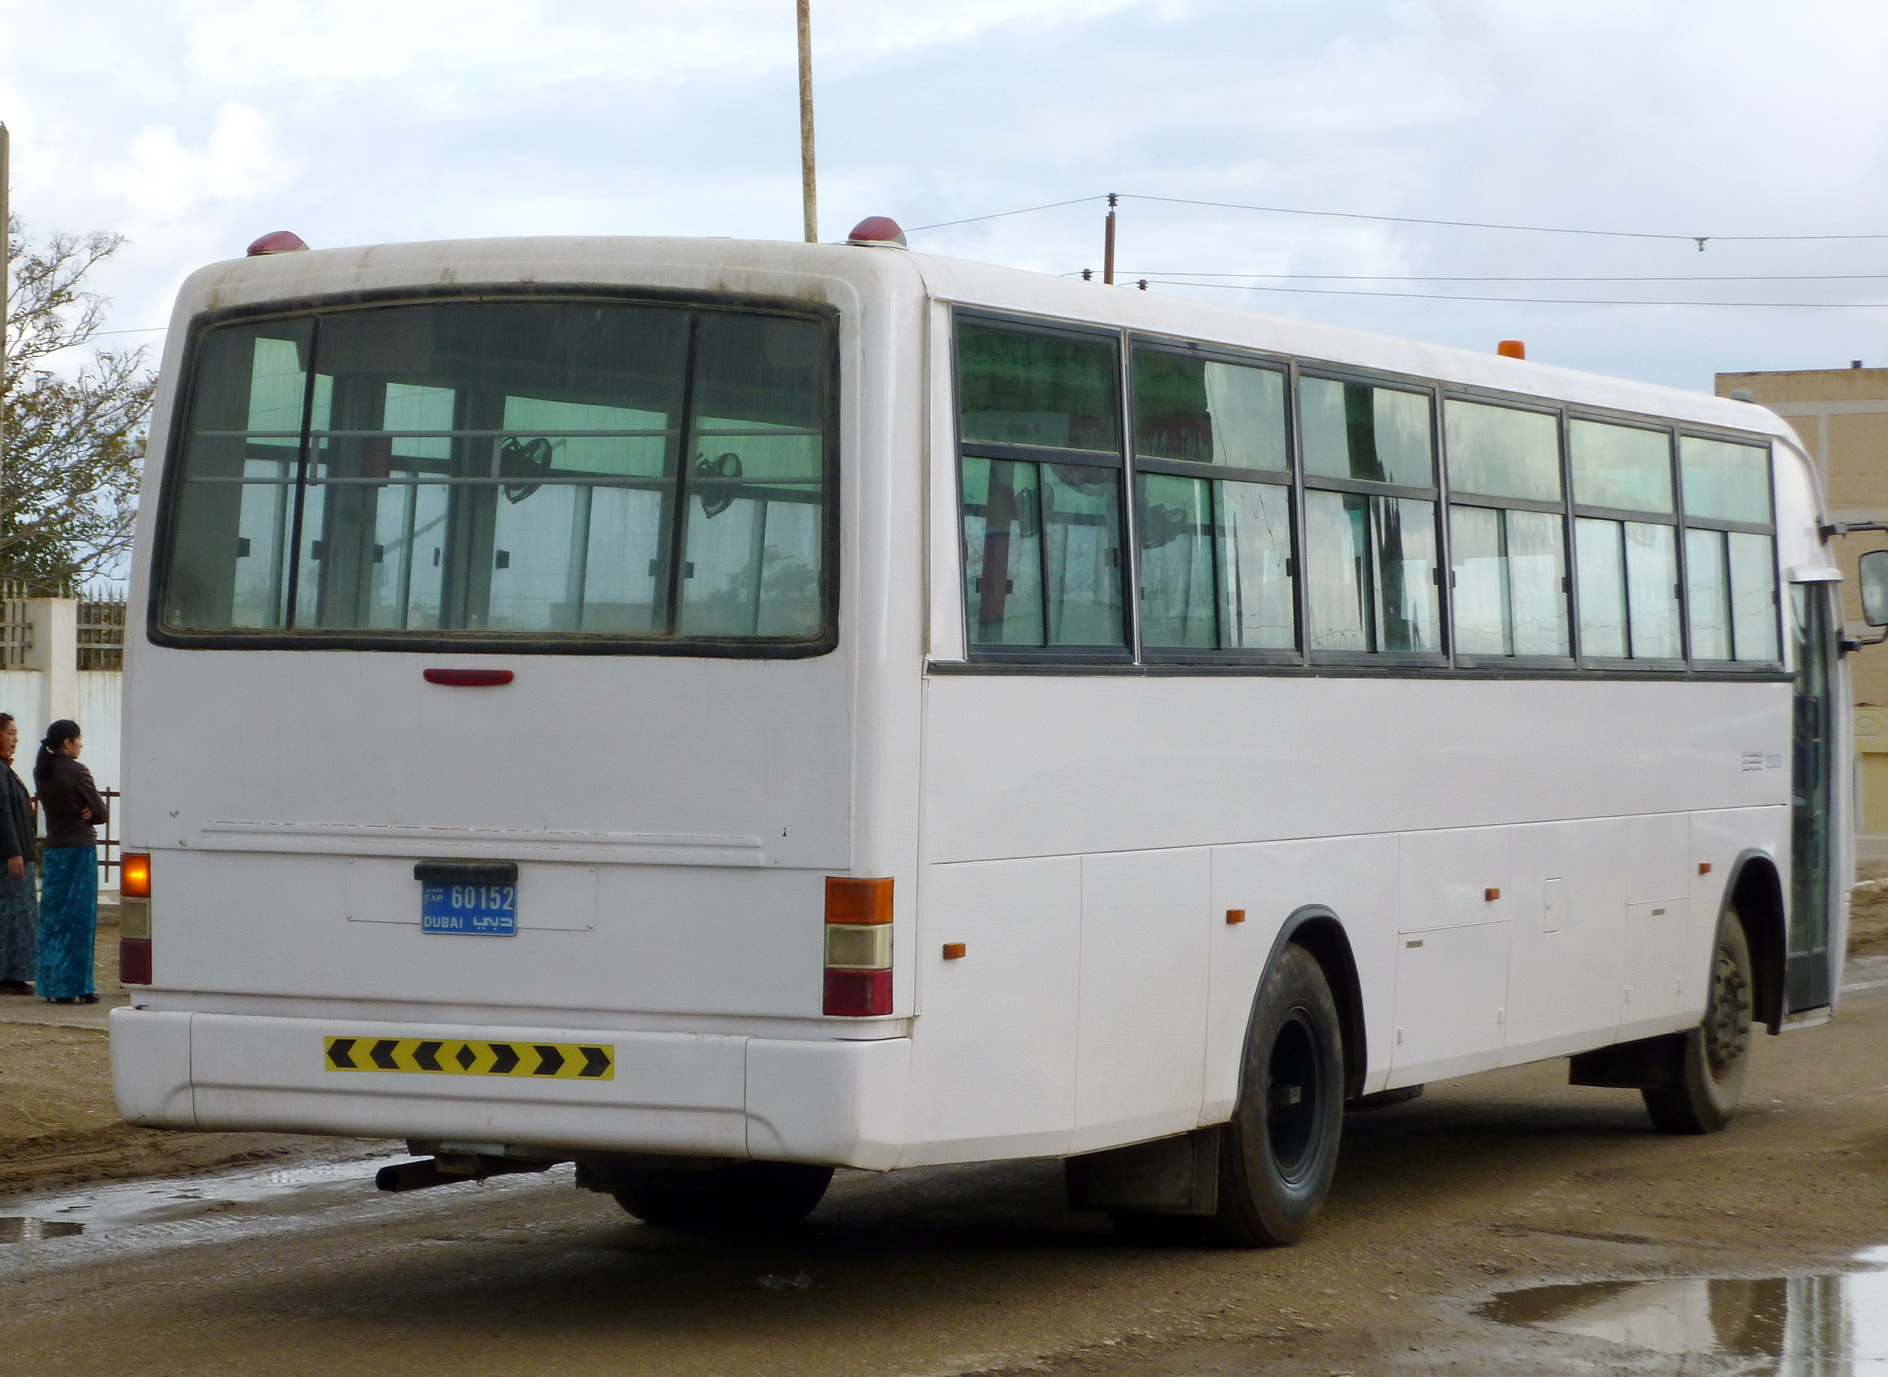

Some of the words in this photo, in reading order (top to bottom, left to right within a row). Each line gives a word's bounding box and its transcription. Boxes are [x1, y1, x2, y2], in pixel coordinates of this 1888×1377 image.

[425, 894, 444, 902] EXP
[451, 886, 514, 911] 60152
[424, 916, 463, 929] DUBAI
[473, 917, 513, 931] دبي
